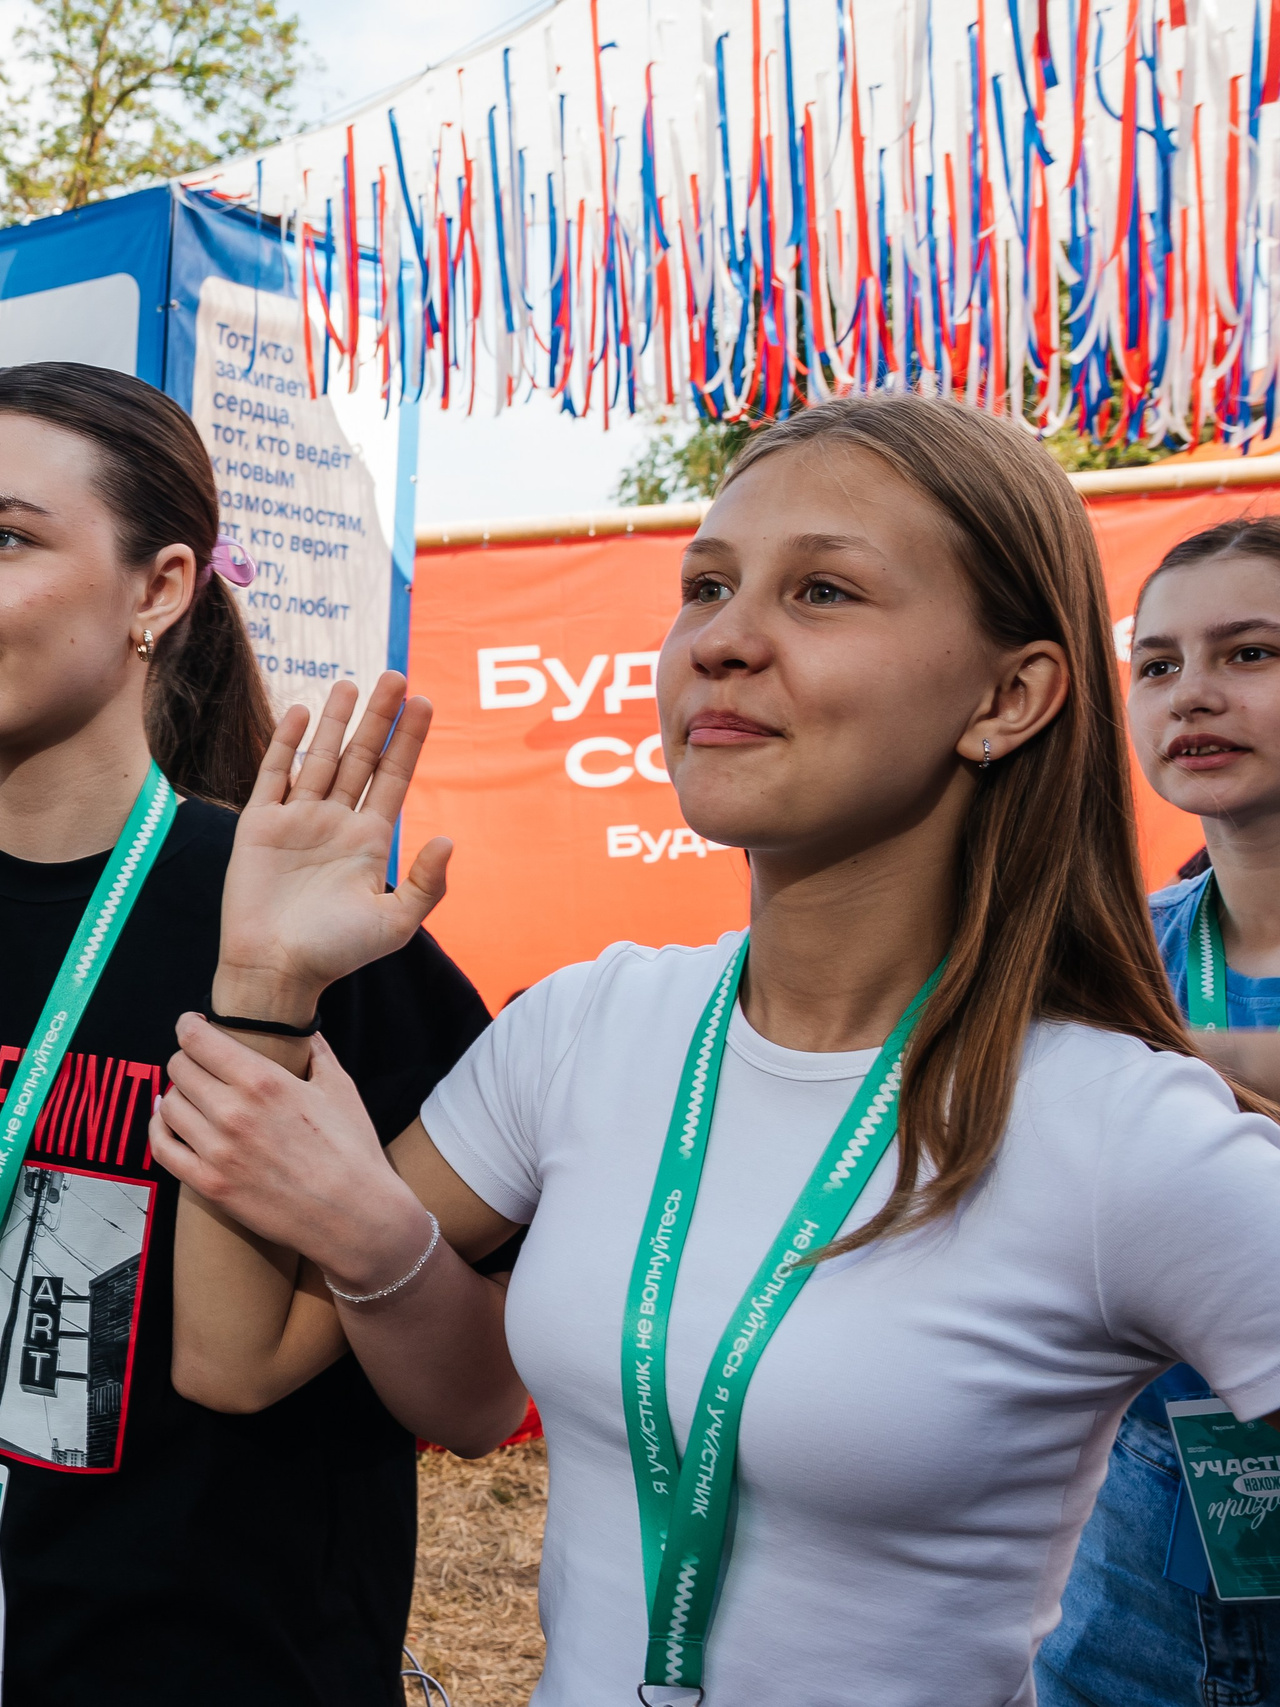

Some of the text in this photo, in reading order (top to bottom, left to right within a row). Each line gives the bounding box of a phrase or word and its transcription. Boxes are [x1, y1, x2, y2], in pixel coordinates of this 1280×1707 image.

[260, 341, 294, 364] кто
[213, 392, 294, 429] сердца,
[212, 423, 351, 470] тот, кто ведёт
[227, 459, 295, 488] новым
[219, 491, 366, 536] озможностям,
[250, 528, 284, 549] кто
[290, 535, 349, 561] верит
[247, 591, 350, 620] кто любит
[246, 617, 276, 644] ей,
[257, 655, 279, 672] то
[284, 658, 339, 679] знает
[3, 1118, 22, 1143] не
[13, 1010, 68, 1117] волнуйтесь
[792, 1219, 820, 1251] не
[639, 1188, 683, 1316] волнуйтесь
[30, 1277, 58, 1382] ART
[722, 1249, 801, 1379] волнуйтесь
[636, 1319, 653, 1349] не
[714, 1385, 730, 1402] я
[653, 1479, 670, 1495] я
